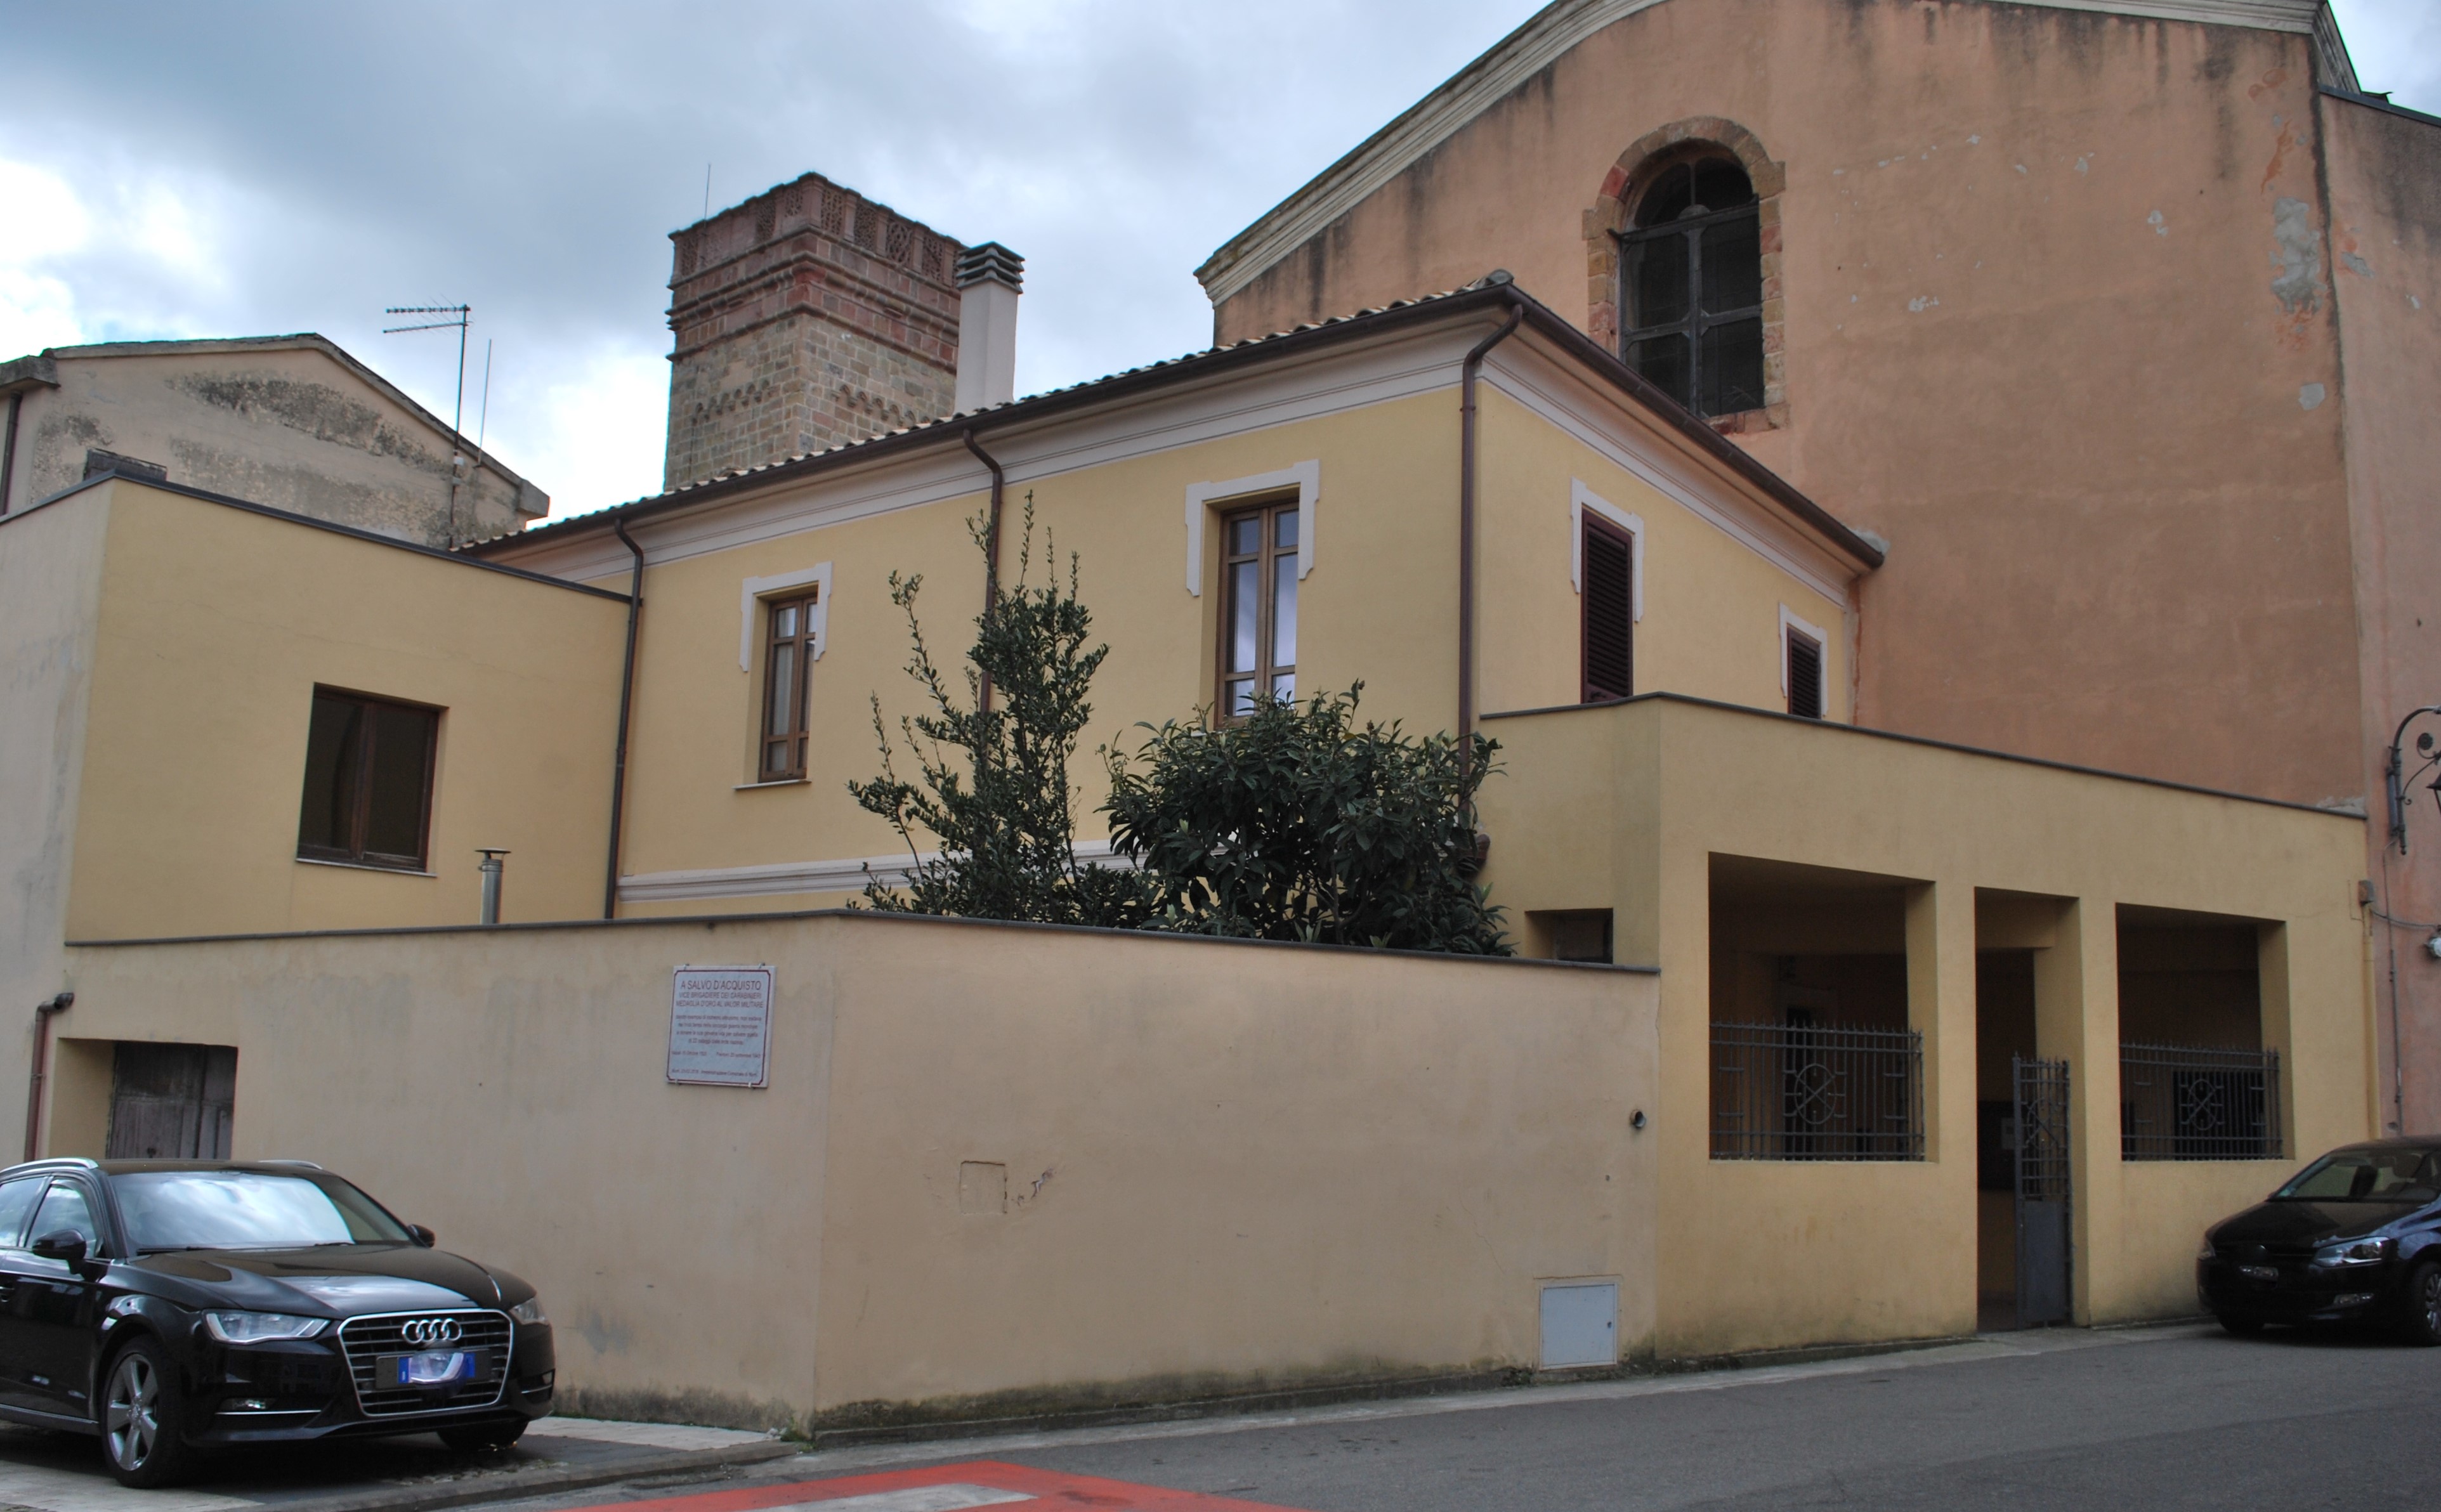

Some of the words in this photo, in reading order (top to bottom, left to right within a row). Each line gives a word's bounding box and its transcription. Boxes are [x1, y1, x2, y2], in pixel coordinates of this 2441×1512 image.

[680, 981, 686, 989] A
[688, 981, 712, 990] SALVO
[714, 981, 762, 991] D'ACQUISTO
